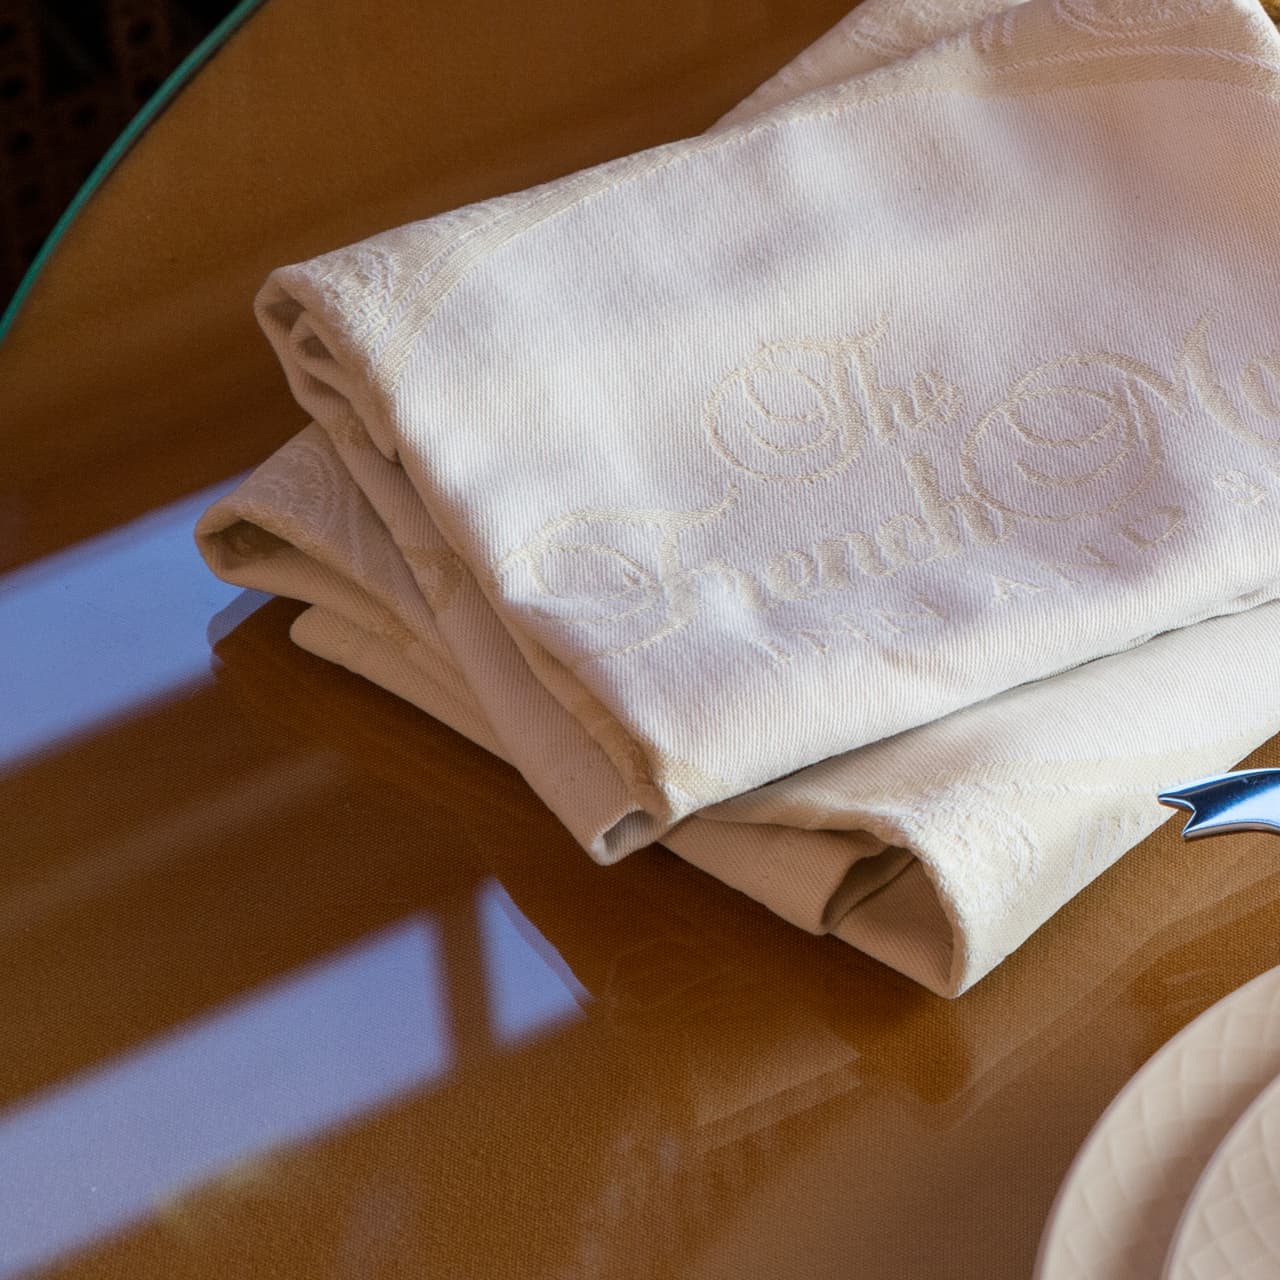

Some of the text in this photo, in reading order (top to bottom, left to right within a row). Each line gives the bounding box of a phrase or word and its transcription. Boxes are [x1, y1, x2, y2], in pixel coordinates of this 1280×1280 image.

[702, 314, 964, 485] The
[497, 454, 1008, 658] French
[992, 503, 1188, 603] AND
